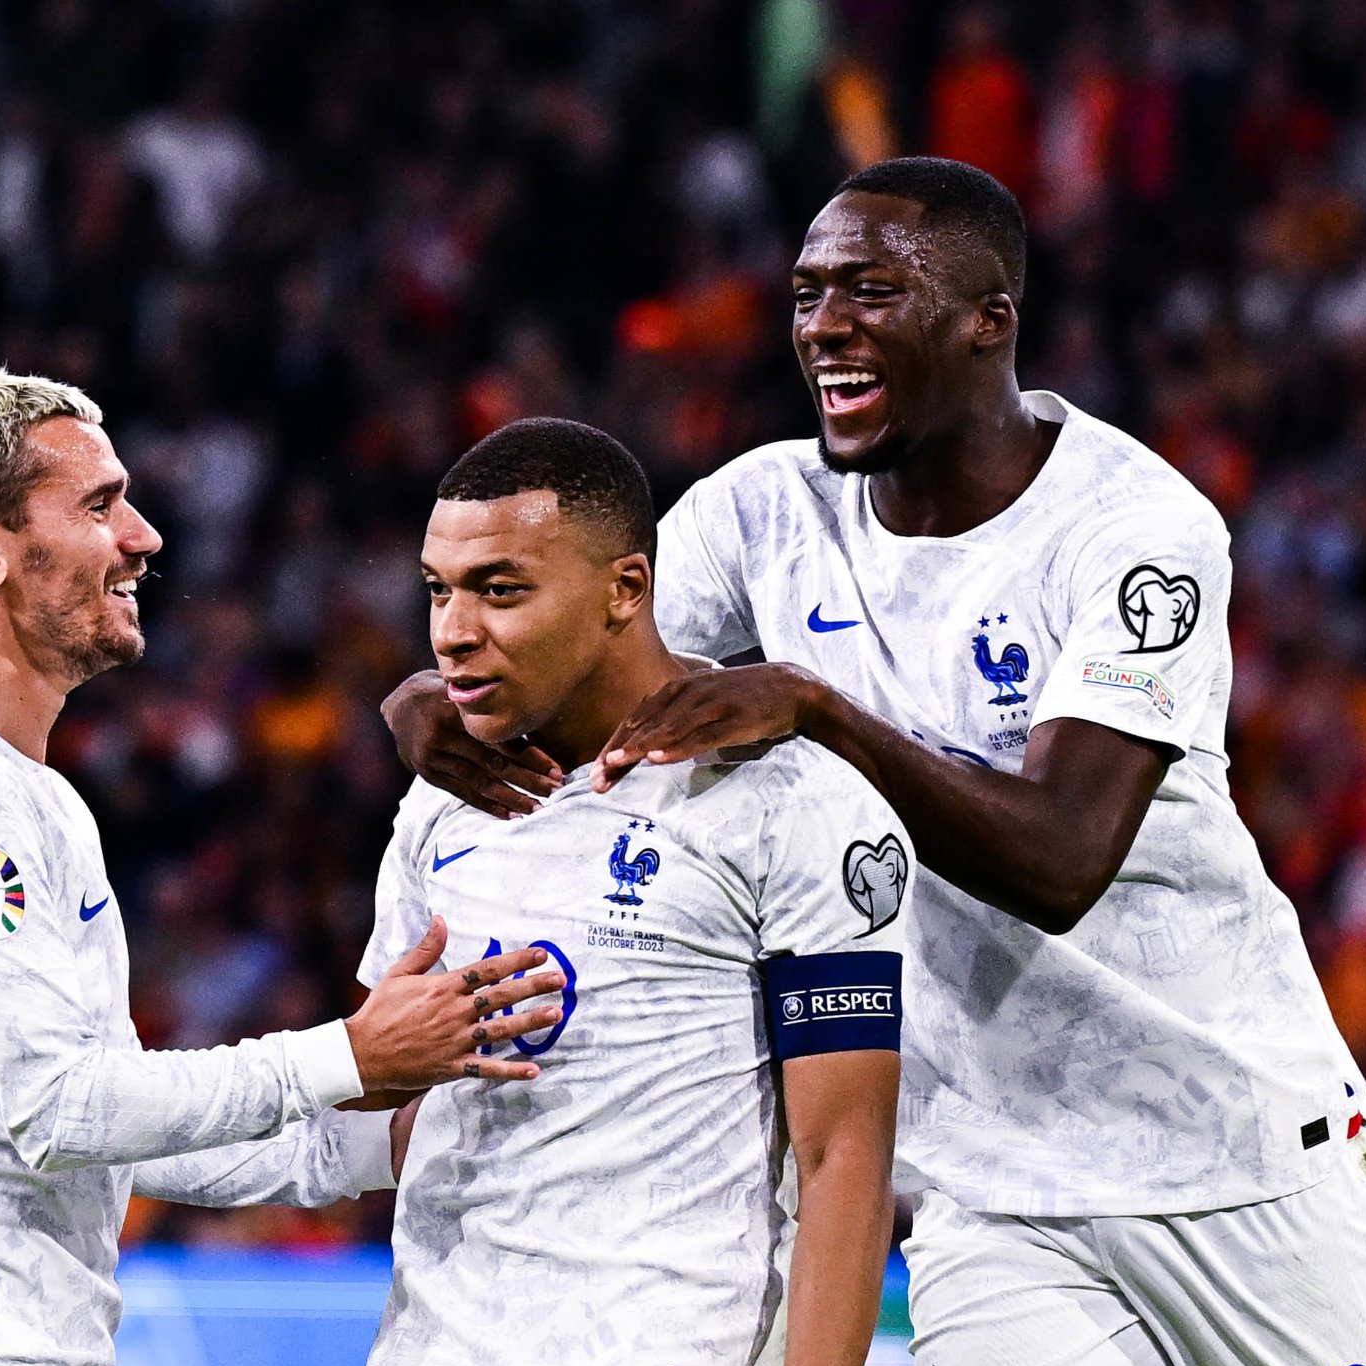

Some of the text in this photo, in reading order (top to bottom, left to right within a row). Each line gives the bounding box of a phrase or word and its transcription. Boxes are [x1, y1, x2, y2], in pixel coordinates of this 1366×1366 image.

[1082, 668, 1175, 712] FOUNDATION
[587, 925, 626, 938] PAYS-BAS
[587, 936, 665, 952] 13 OCTOBRE 2023
[811, 992, 893, 1013] RESPECT
